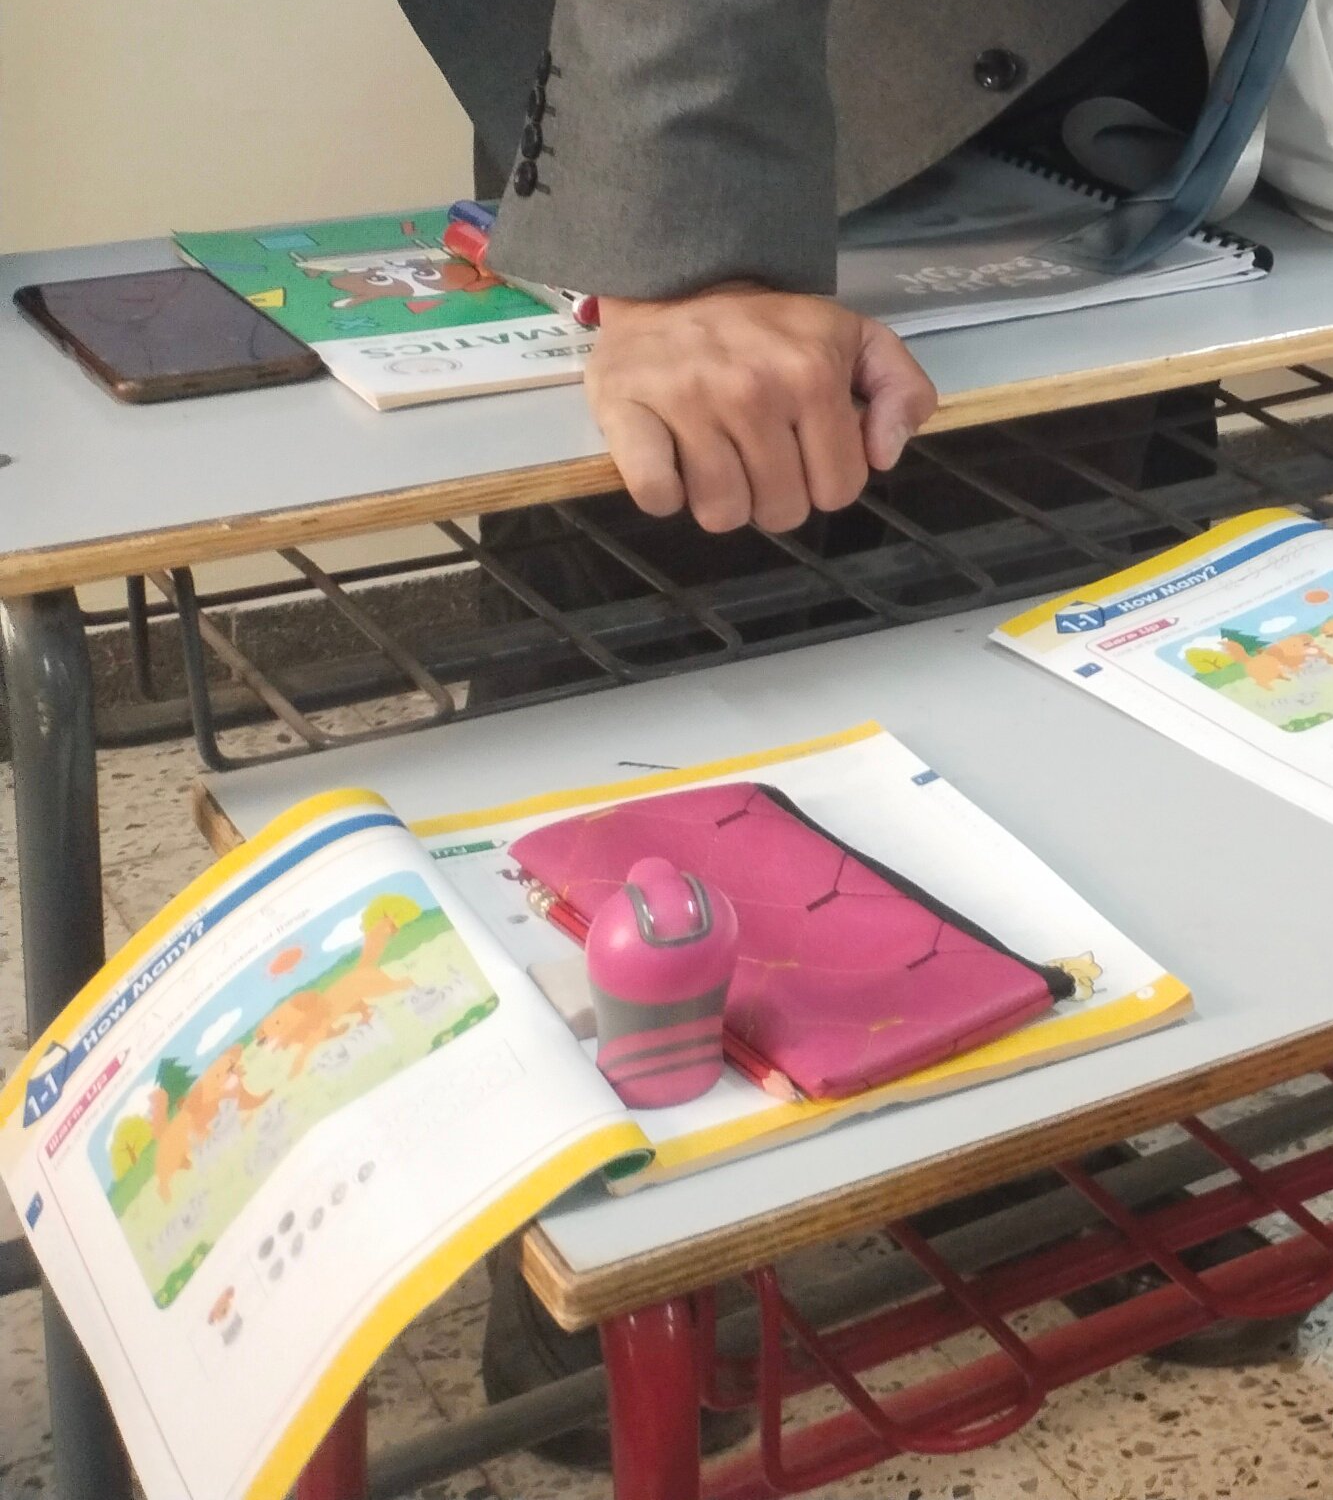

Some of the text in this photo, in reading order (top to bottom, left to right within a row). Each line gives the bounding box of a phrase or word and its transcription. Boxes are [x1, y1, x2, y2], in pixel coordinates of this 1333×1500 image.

[360, 321, 600, 361] EMATICS
[1061, 613, 1099, 632] 1-1
[1117, 591, 1160, 613] How
[1160, 565, 1219, 597] Many?
[28, 1072, 59, 1118] 1-1
[82, 999, 128, 1052] How
[131, 919, 205, 999] Many?
[48, 1074, 108, 1151] Warm Up
